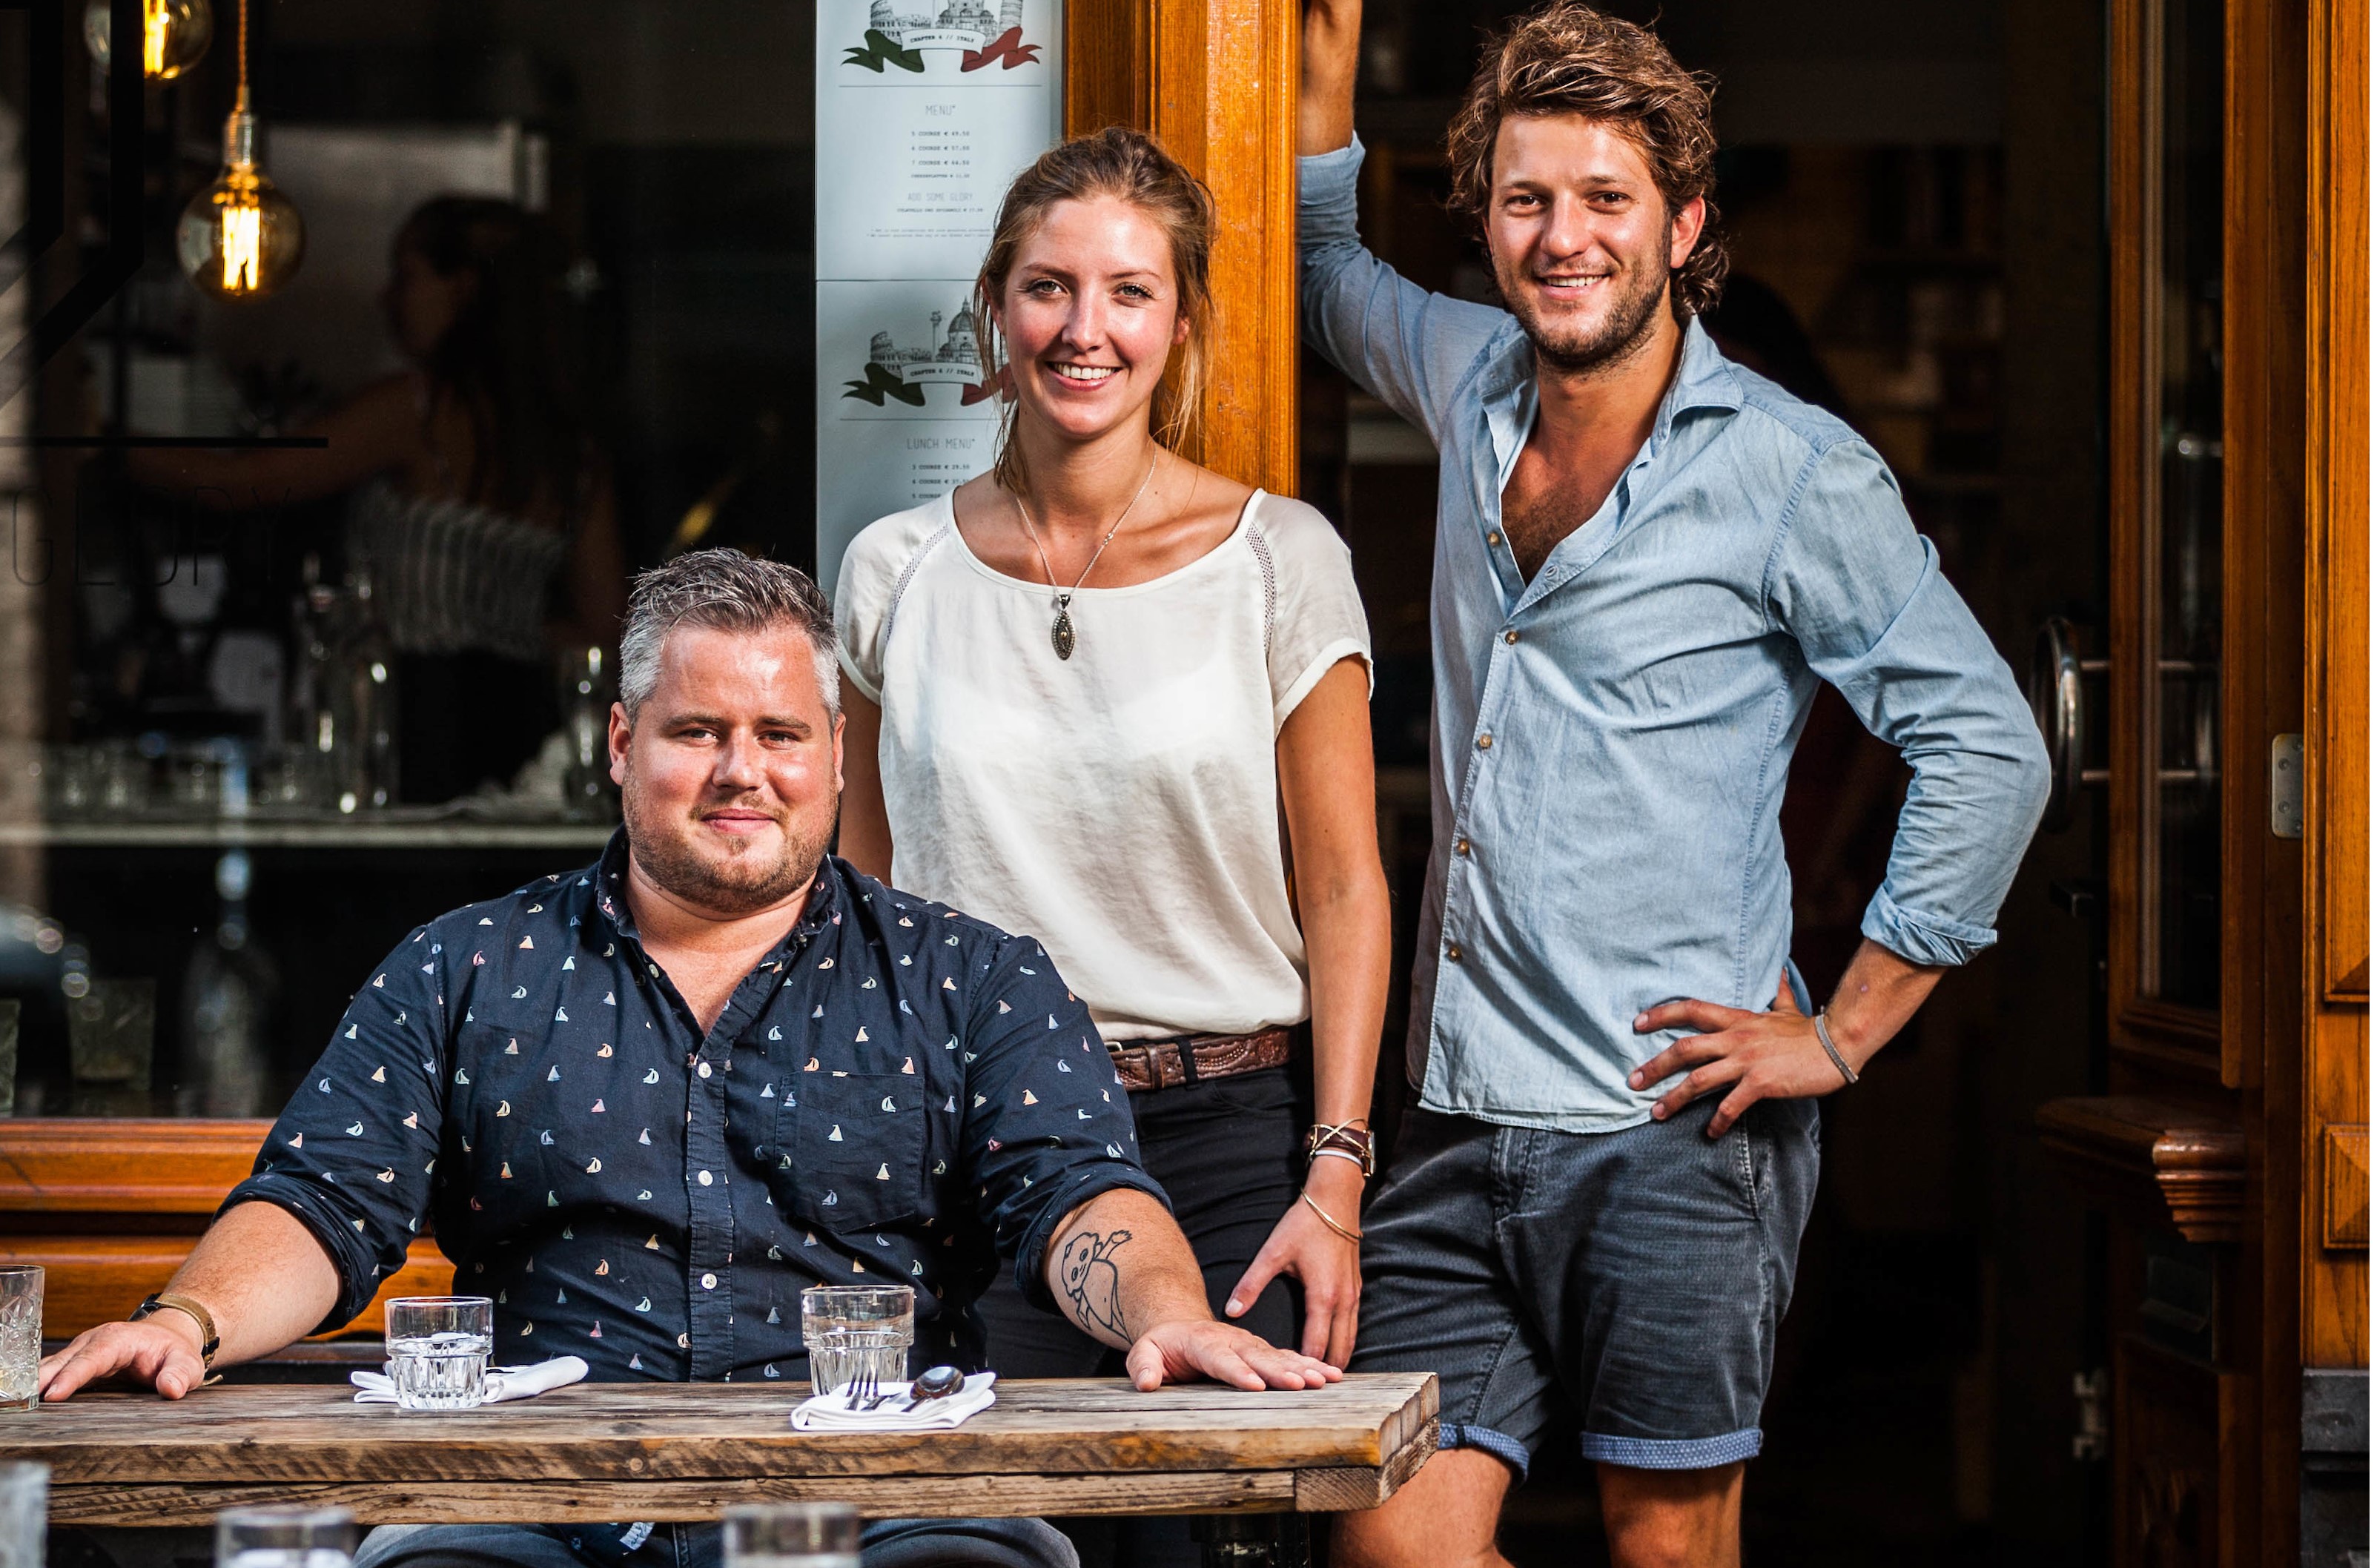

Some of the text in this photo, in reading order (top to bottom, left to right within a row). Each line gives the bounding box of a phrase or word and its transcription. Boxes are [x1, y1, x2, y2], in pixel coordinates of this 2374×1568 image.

[910, 35, 935, 43] CHAPTER
[926, 192, 944, 202] SOME
[949, 192, 973, 202] GLORY
[910, 368, 936, 377] CHAPTER
[907, 438, 939, 449] LUNCH
